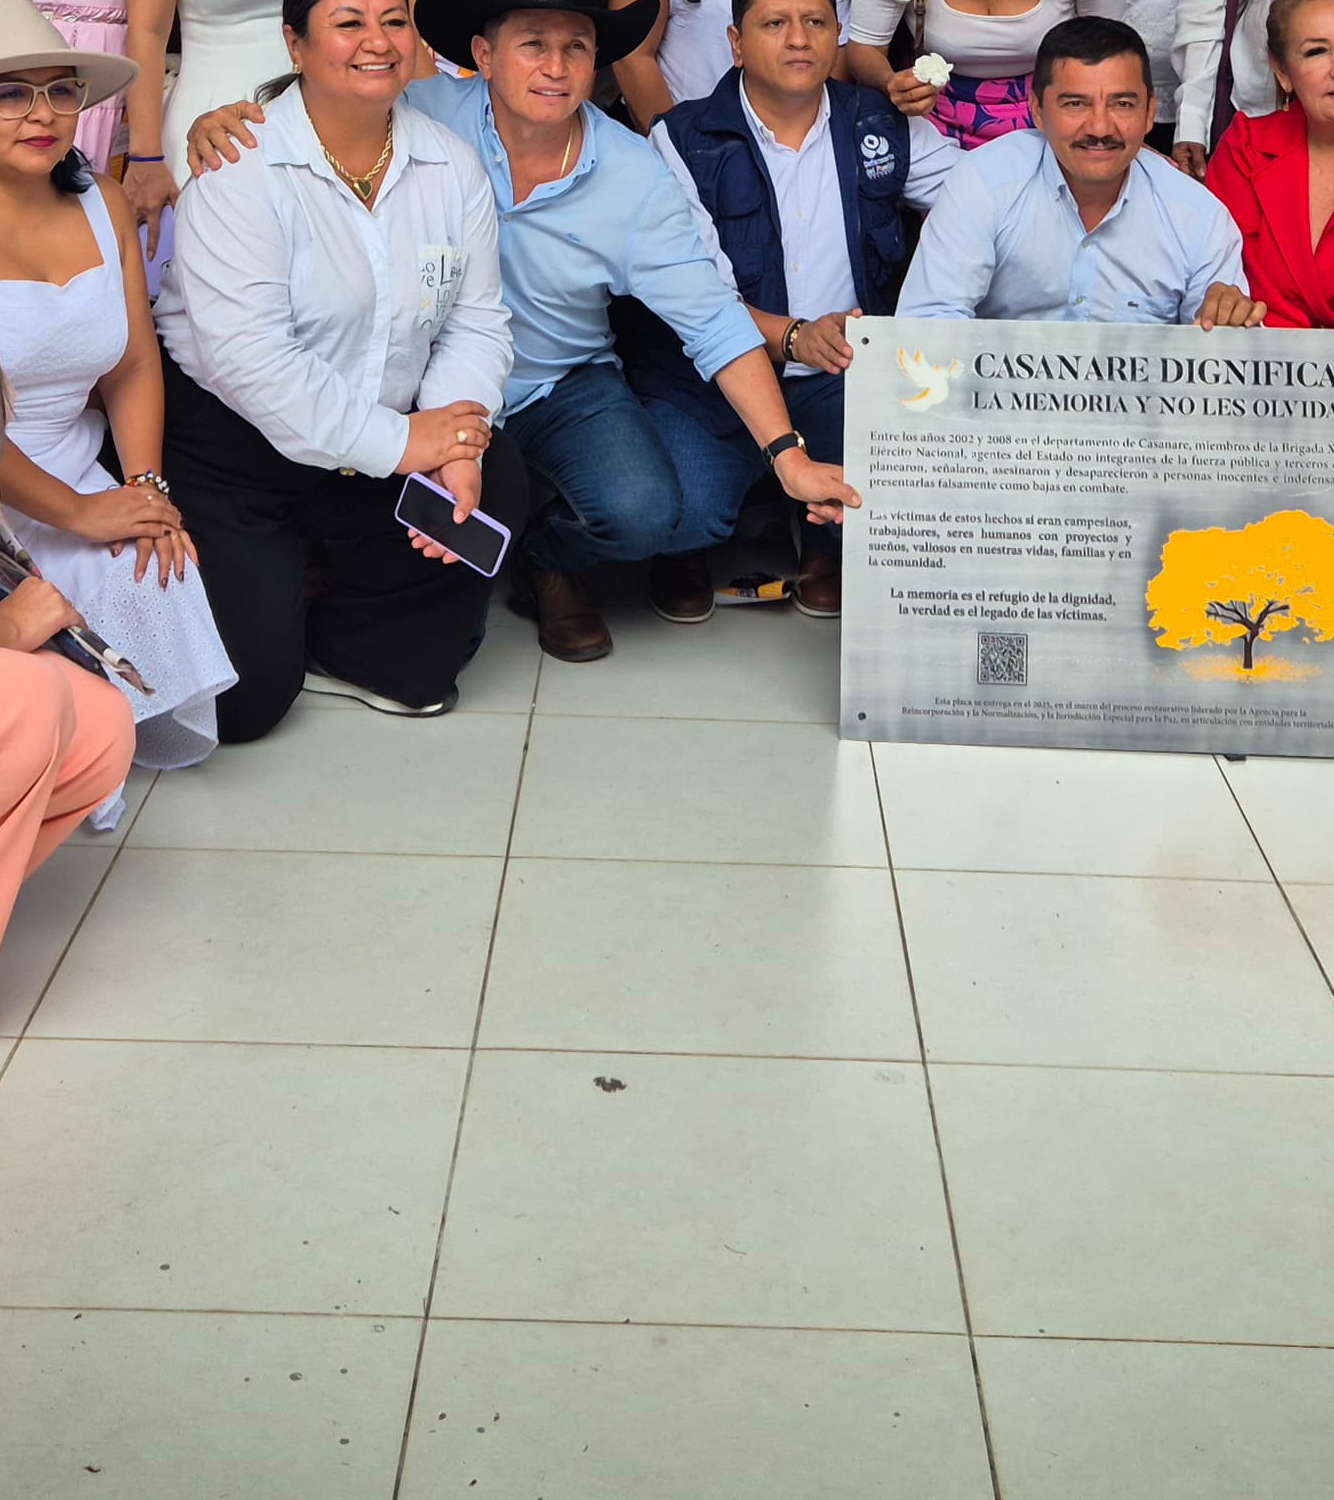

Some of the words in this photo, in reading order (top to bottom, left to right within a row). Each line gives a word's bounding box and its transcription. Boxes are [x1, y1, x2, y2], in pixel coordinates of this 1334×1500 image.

[974, 352, 1149, 383] CASANARE
[973, 390, 1003, 410] LA
[1010, 391, 1127, 413] MEMORIA
[1135, 395, 1151, 414] Y
[1158, 395, 1195, 415] NO
[1202, 396, 1246, 417] LES
[870, 430, 900, 442] Entre
[902, 431, 917, 442] los
[920, 432, 946, 443] años
[948, 433, 974, 444] 2002
[976, 435, 983, 447] y
[986, 434, 1012, 445] 2008
[1014, 437, 1027, 445] en
[1030, 435, 1040, 446] el
[1042, 435, 1120, 451] departamento
[1122, 436, 1136, 449] de
[1138, 437, 1192, 451] Casanare,
[1195, 439, 1251, 452] miembros
[1252, 440, 1266, 452] de
[1268, 441, 1279, 453] la
[1281, 442, 1324, 457] Brigada
[869, 445, 912, 459] Ejército
[915, 446, 967, 460] Nacional,
[971, 449, 1012, 463] agentes
[1015, 448, 1032, 461] del
[1036, 449, 1073, 462] Estado
[1077, 453, 1091, 462] no
[1095, 451, 1157, 468] integrantes
[1160, 453, 1174, 465] de
[1177, 454, 1187, 465] la
[1191, 454, 1226, 467] fuerza
[1230, 455, 1270, 471] pública
[1274, 459, 1281, 471] y
[1284, 459, 1328, 469] terceros
[869, 460, 927, 476] planearon,
[931, 461, 988, 475] señalaron,
[992, 464, 1050, 476] asesinaron
[1054, 468, 1061, 479] y
[1065, 466, 1148, 482] desaparecieron
[1152, 470, 1159, 479] a
[1163, 471, 1212, 484] personas
[1216, 470, 1268, 483] inocentes
[1272, 475, 1279, 483] e
[869, 475, 935, 491] presentarlas
[937, 477, 997, 490] falsamente
[999, 482, 1030, 491] como
[1032, 479, 1061, 494] bajas
[1062, 483, 1076, 492] en
[1078, 481, 1128, 494] combate.
[890, 509, 936, 522] víctimas
[938, 511, 952, 523] de
[954, 513, 982, 524] estos
[984, 512, 1023, 525] hechos
[1025, 513, 1034, 525] sí
[1036, 516, 1062, 526] eran
[1063, 515, 1131, 531] campesinos,
[868, 523, 940, 540] trabajadores,
[946, 529, 974, 539] seres
[980, 527, 1032, 540] humanos
[1037, 532, 1058, 541] con
[1065, 531, 1119, 546] proyectos
[1125, 535, 1132, 547] y
[868, 539, 909, 553] sueños,
[912, 540, 956, 554] valiosos
[959, 545, 973, 554] en
[976, 544, 1023, 556] nuestras
[1025, 543, 1058, 558] vidas,
[1061, 545, 1106, 558] familias
[1108, 549, 1115, 561] y
[1118, 550, 1131, 559] en
[868, 555, 878, 566] la
[880, 555, 946, 569] comunidad.
[890, 587, 904, 599] La
[906, 588, 959, 601] memoria
[960, 592, 973, 601] es
[975, 589, 985, 602] el
[988, 589, 1029, 606] refugio
[1031, 590, 1046, 604] de
[1048, 591, 1059, 604] la
[1061, 591, 1116, 609] dignidad,
[898, 602, 909, 615] la
[911, 602, 951, 616] verdad
[952, 607, 965, 617] es
[967, 604, 977, 617] el
[980, 605, 1018, 621] legado
[1020, 606, 1034, 619] de
[1036, 606, 1052, 620] las
[1055, 607, 1107, 621] víctimas.
